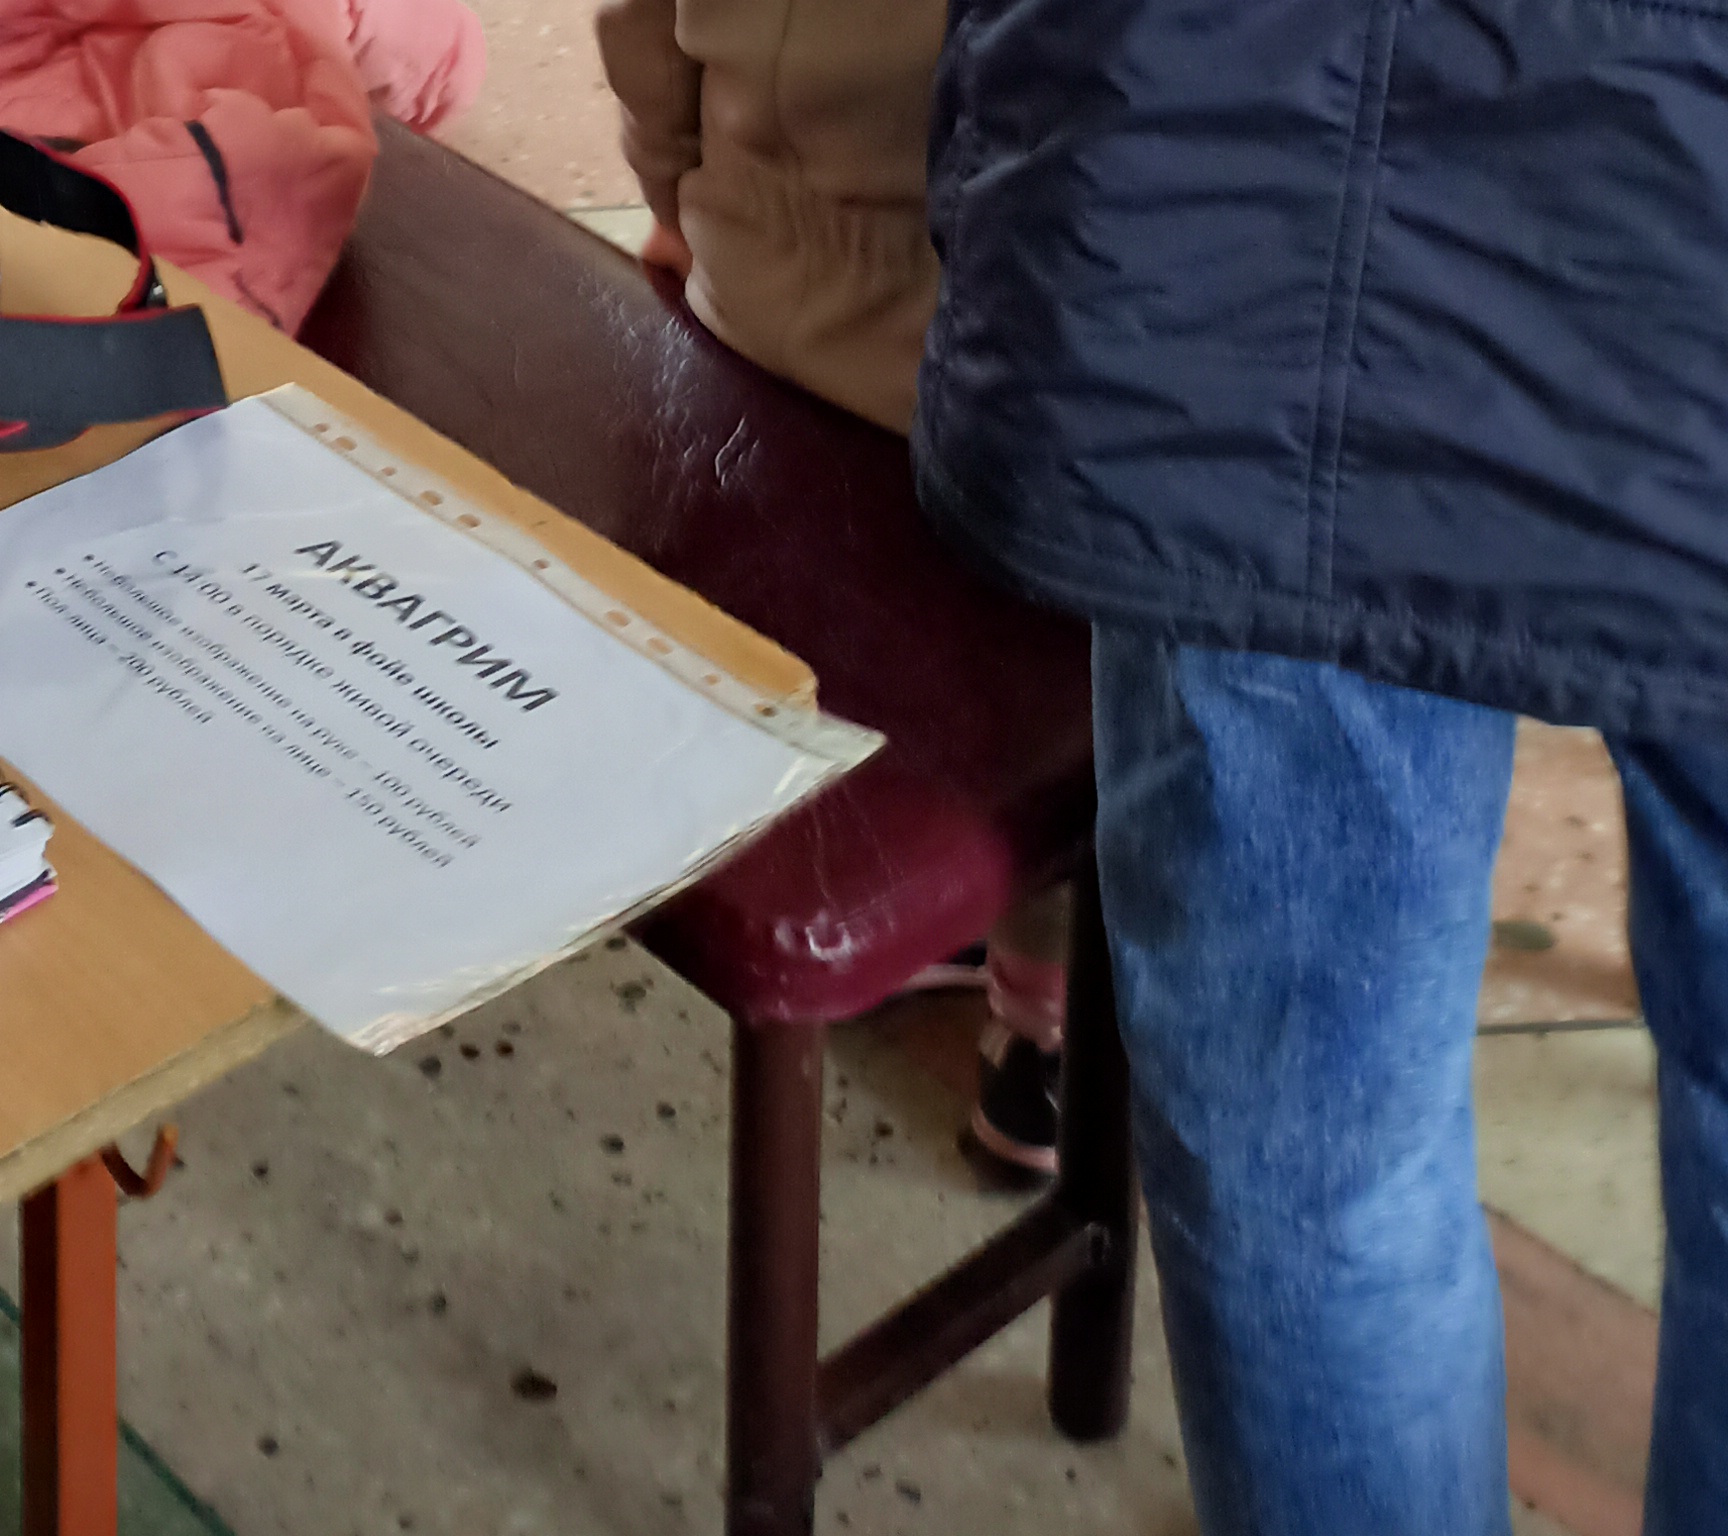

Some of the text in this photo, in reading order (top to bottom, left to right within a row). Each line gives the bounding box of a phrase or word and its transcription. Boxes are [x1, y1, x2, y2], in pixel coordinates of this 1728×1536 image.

[65, 574, 152, 640] Небольшое
[151, 640, 263, 724] изображение
[260, 724, 286, 744] на
[285, 744, 331, 778] лице
[346, 787, 385, 815] 150
[376, 815, 455, 868] рублей
[93, 559, 182, 626] Небольшое
[180, 626, 292, 708] изображение
[290, 709, 315, 728] на
[310, 727, 359, 760] руке
[373, 770, 411, 797] 100
[402, 797, 481, 849] рублей
[118, 652, 155, 677] 200
[144, 676, 215, 723] рублей
[226, 603, 245, 617] в
[241, 614, 334, 679] порядке
[329, 679, 415, 739] живой
[408, 737, 513, 814] очереди
[240, 562, 501, 750] 17 марта в фойе школы
[293, 539, 559, 713] АКВАГРИМ
